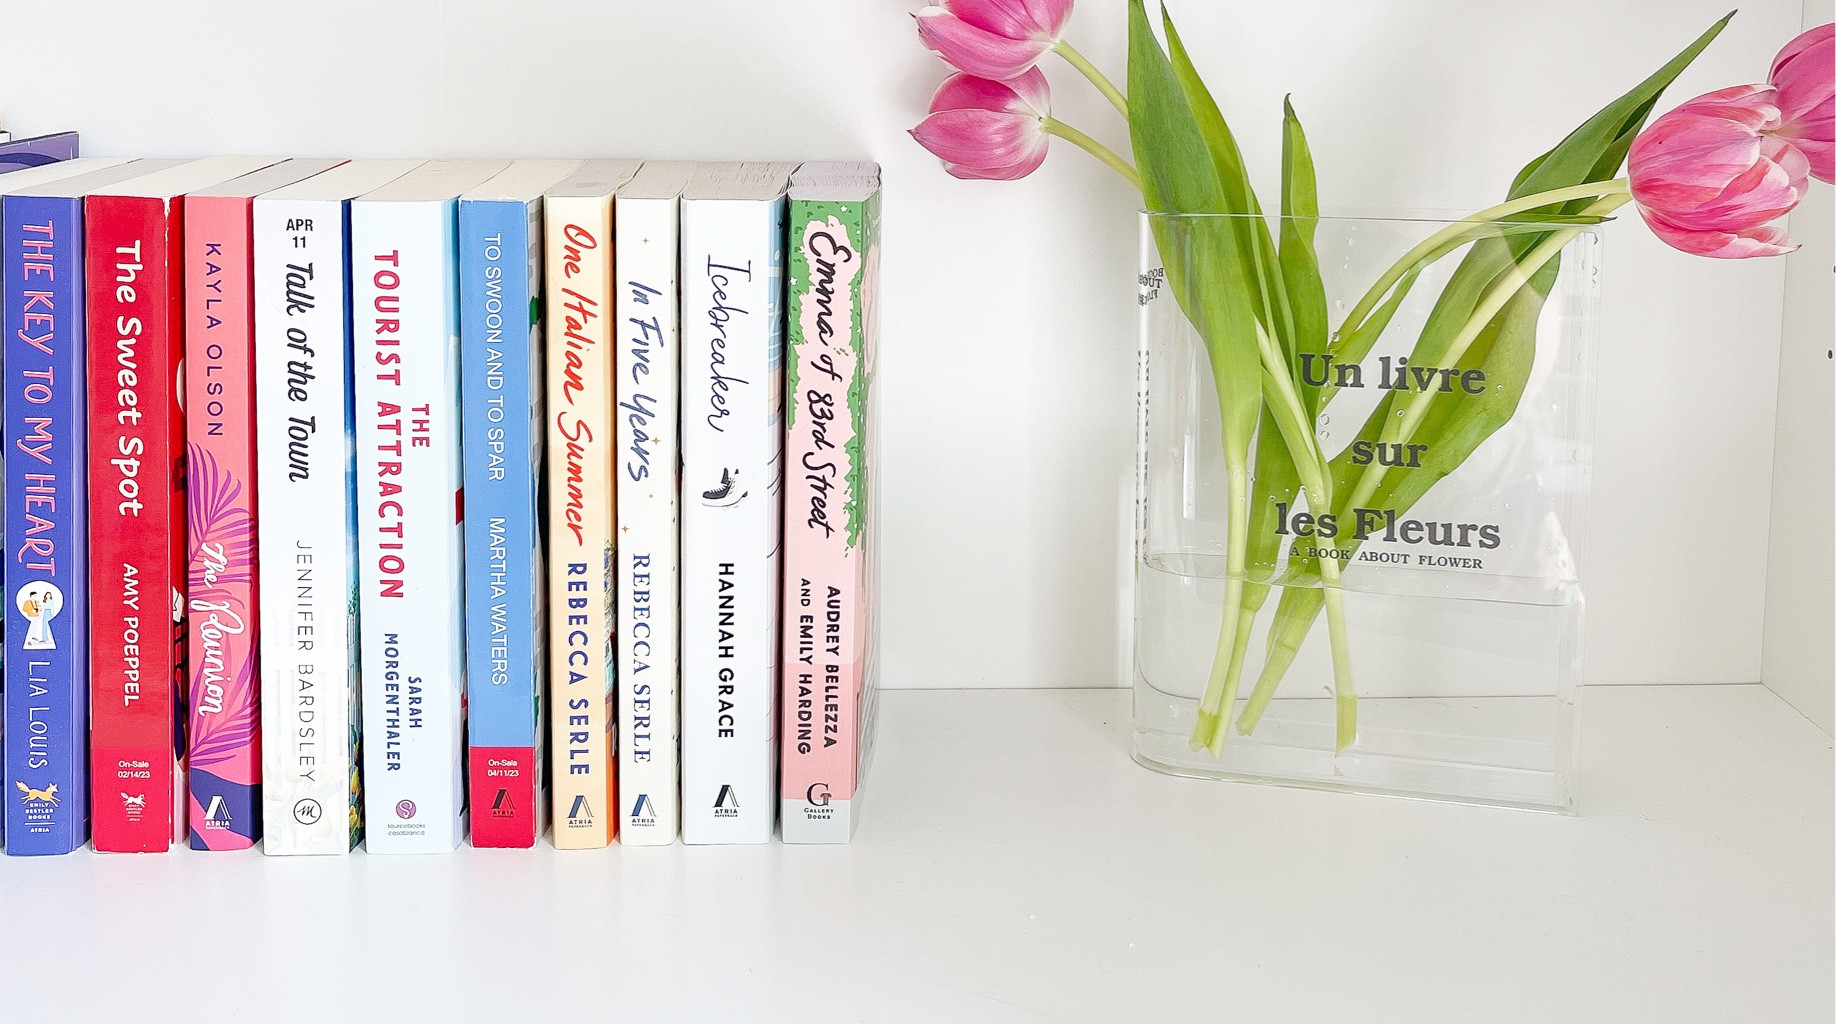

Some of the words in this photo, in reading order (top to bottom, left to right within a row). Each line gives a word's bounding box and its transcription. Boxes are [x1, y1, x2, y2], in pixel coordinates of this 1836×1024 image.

[23, 220, 54, 282] THE
[286, 218, 313, 232] APR
[292, 236, 307, 249] 11
[484, 233, 501, 261] TO
[564, 223, 597, 279] One
[115, 239, 143, 304] The
[205, 243, 223, 330] KAYLA
[285, 262, 316, 317] Talk
[484, 265, 503, 344] SWOON
[628, 280, 662, 305] In
[808, 231, 852, 346] Emma
[286, 328, 315, 358] of
[373, 250, 401, 387] TOURIST
[561, 287, 598, 406] Italian
[629, 316, 664, 385] Five
[706, 254, 751, 433] Icebreaker
[23, 366, 54, 404] TO
[116, 315, 143, 426] Sweet
[206, 344, 224, 437] OLSON
[287, 360, 316, 403] the
[487, 348, 504, 390] AND
[811, 354, 843, 383] of
[1299, 353, 1364, 390] Un
[1378, 356, 1487, 395] livre
[411, 403, 430, 448] THE
[487, 395, 504, 423] TO
[619, 393, 657, 483] Years
[806, 389, 835, 451] 83rd
[110, 435, 144, 518] Spot
[288, 416, 316, 483] Town
[488, 428, 505, 481] SPAR
[557, 411, 593, 547] Summer
[1352, 439, 1428, 468] sur
[17, 473, 56, 577] HEART
[377, 401, 405, 599] ATTRACTION
[802, 451, 837, 539] Street
[1275, 503, 1338, 539] les
[1353, 509, 1501, 550] Fleurs
[122, 562, 140, 615] AMY
[201, 542, 229, 590] The
[489, 516, 507, 600] MARTHA
[1290, 546, 1300, 557] A
[1308, 548, 1350, 560] BOOK
[1358, 551, 1410, 564] ABOUT
[1419, 556, 1483, 569] FLOWER
[296, 540, 314, 652] JENNIFER
[567, 562, 589, 685] REBECCA
[632, 553, 651, 676] REBECCA
[718, 562, 735, 660] HANNAH
[800, 578, 811, 607] AND
[824, 585, 841, 657] AUDREY
[123, 617, 140, 707] POEPPEL
[191, 599, 245, 717] Reunion
[491, 603, 508, 686] WATERS
[799, 614, 814, 666] EMILY
[27, 659, 51, 699] LIA
[384, 632, 401, 772] MORGENTHALER
[408, 676, 423, 729] SARAH
[718, 668, 735, 739] GRACE
[823, 664, 841, 748] BELLEZZA
[297, 664, 316, 783] BARDSLEY
[569, 698, 590, 775] SERLE
[633, 683, 651, 764] SERLE
[797, 673, 813, 755] HARDING
[117, 771, 151, 779] 02/14/23
[118, 760, 150, 768] On-Sale
[487, 769, 519, 777] 04/11/23
[488, 759, 518, 767] On-Sale
